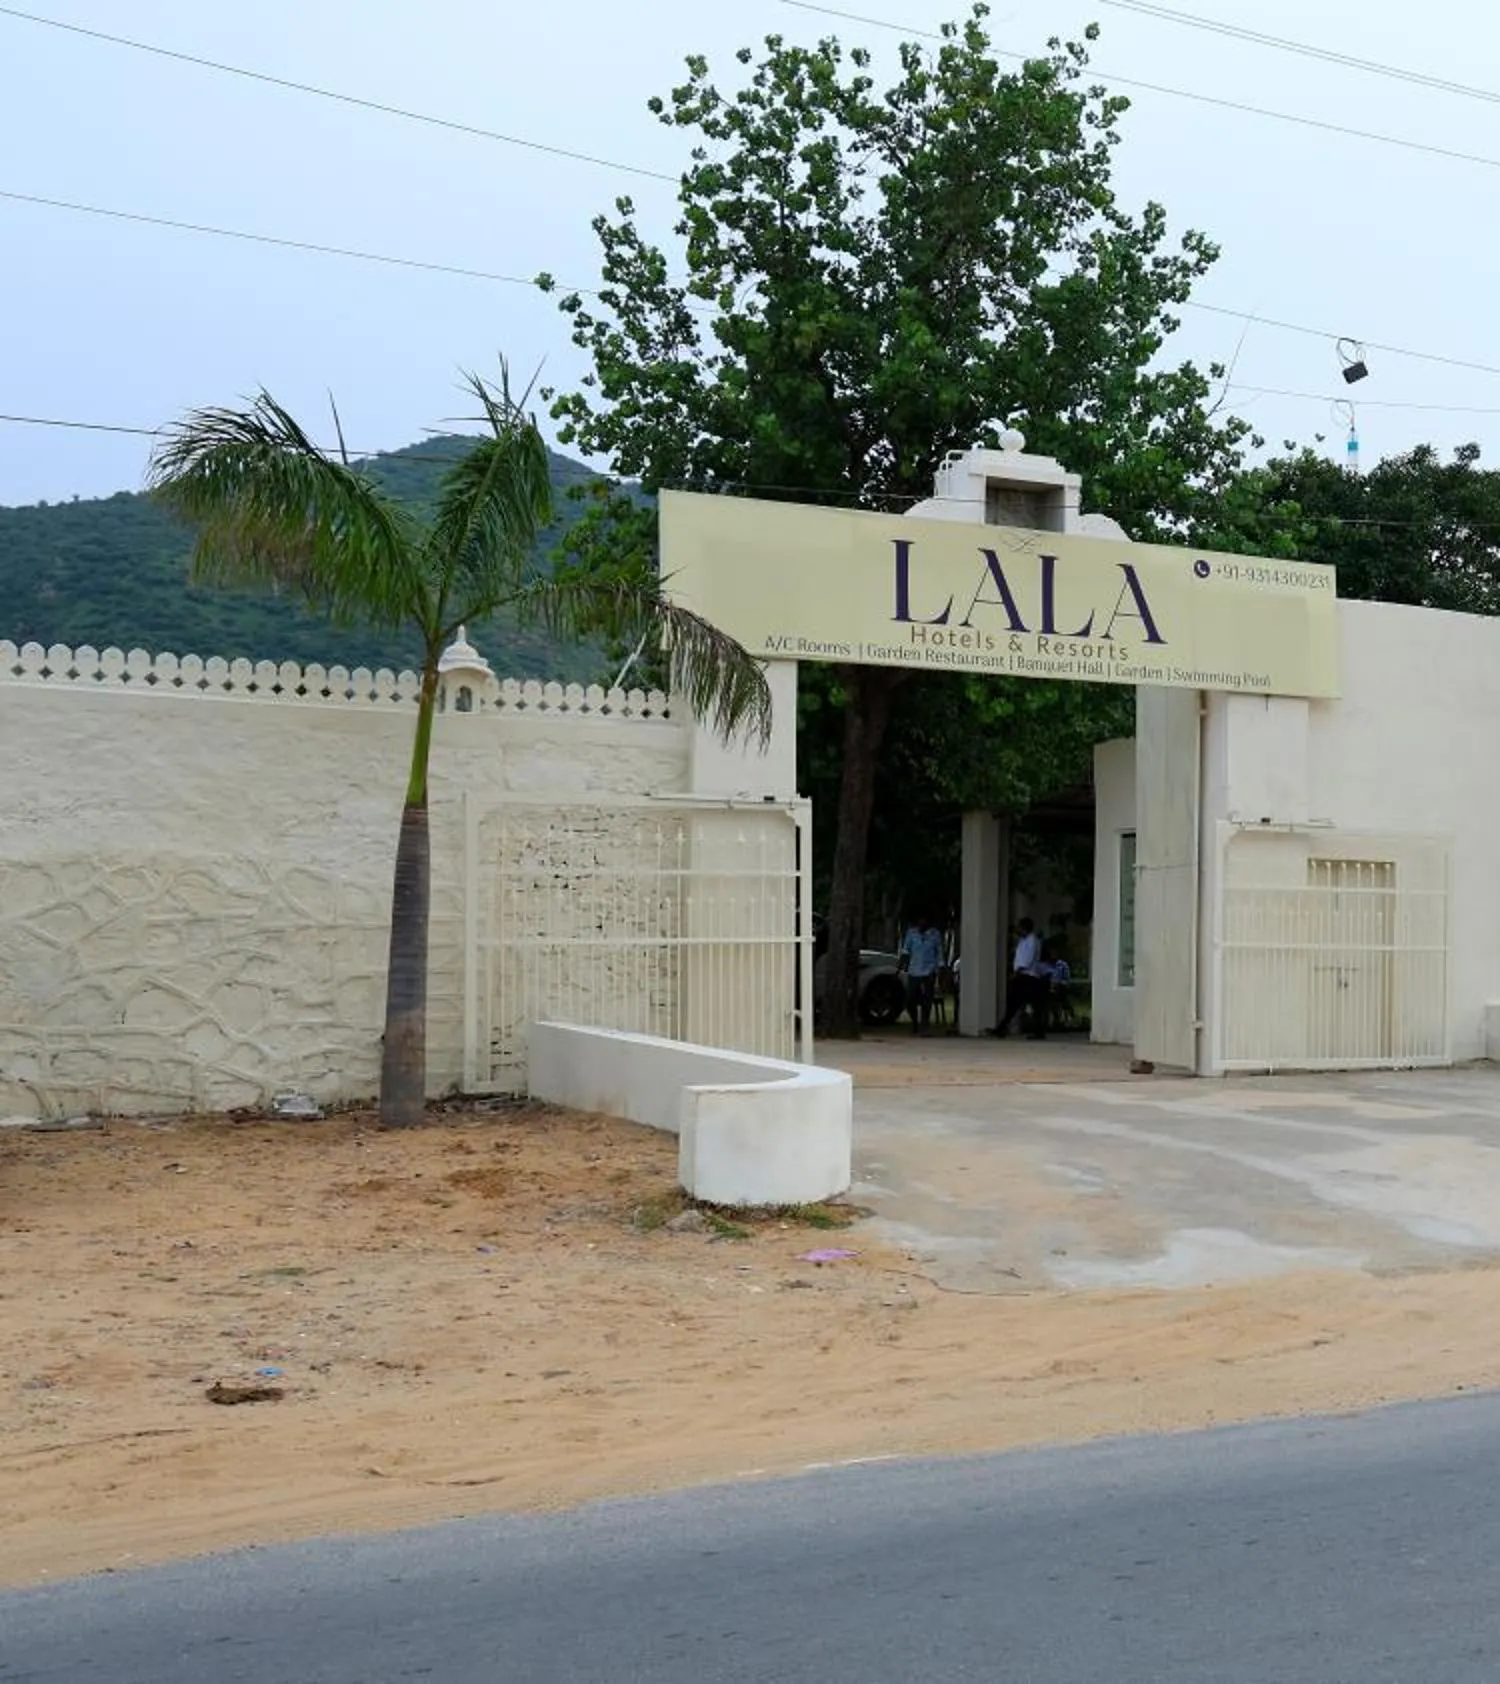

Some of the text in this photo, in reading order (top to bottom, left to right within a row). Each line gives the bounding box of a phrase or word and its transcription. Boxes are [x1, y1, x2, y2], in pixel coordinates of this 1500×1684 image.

[890, 540, 1168, 644] LALA
[765, 635, 794, 650] A/C
[799, 638, 851, 655] Rooms
[867, 643, 921, 659] Garden
[925, 647, 1004, 668] Restaurant
[1017, 655, 1074, 674] Banquet
[1077, 660, 1104, 675] Hall
[1115, 664, 1163, 681] Garden
[911, 625, 1129, 661] Hotels & Resorts
